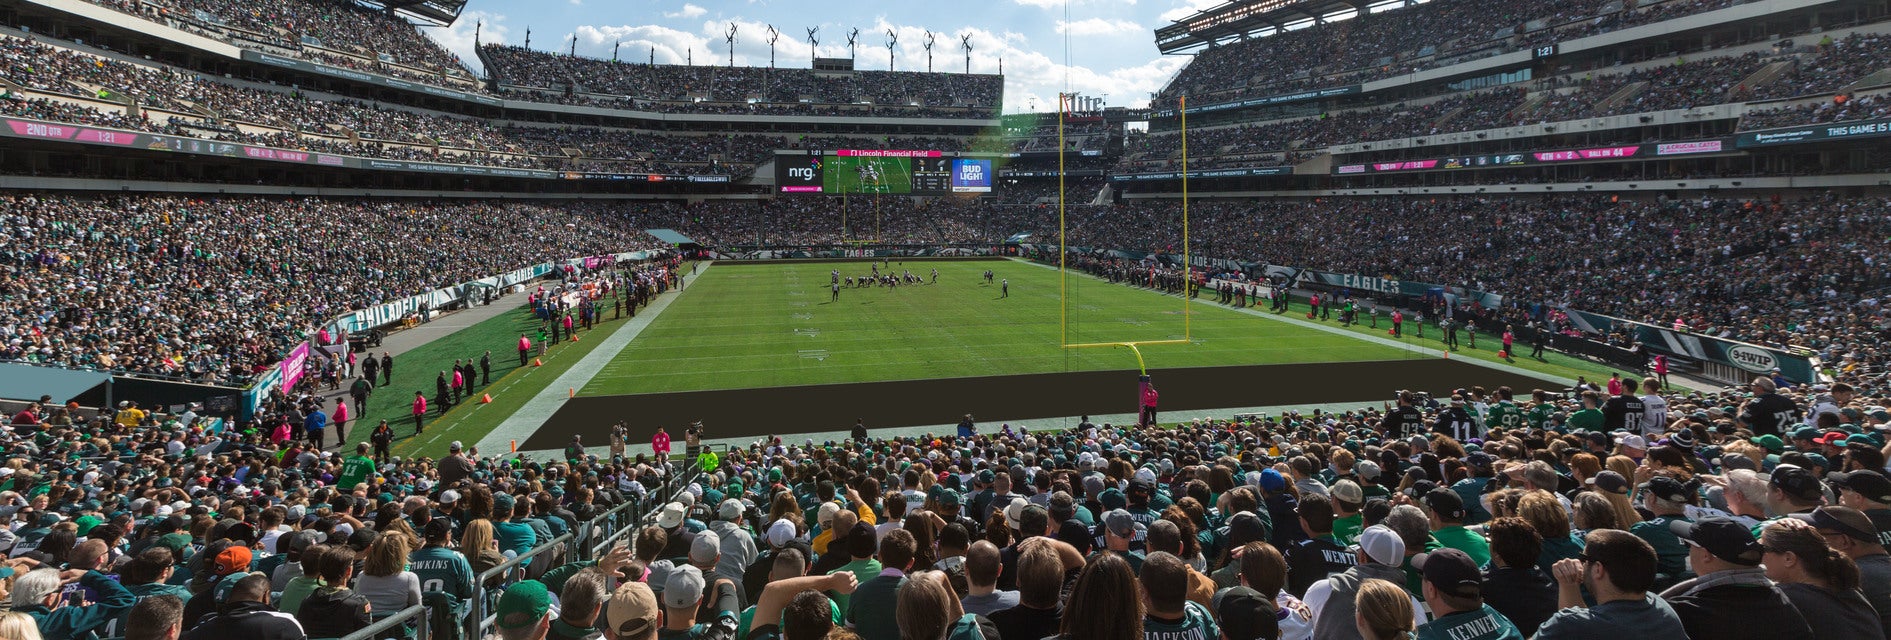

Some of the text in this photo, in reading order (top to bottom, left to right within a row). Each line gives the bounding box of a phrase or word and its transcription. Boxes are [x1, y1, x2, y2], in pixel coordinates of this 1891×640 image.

[1538, 46, 1552, 56] 1:21
[27, 123, 47, 135] 2ND
[1827, 122, 1888, 137] THIS GAME IS
[98, 131, 115, 143] 1:21
[858, 149, 882, 157] Lincoln
[883, 149, 912, 157] Financial
[1541, 152, 1554, 160] 4TH
[1567, 151, 1572, 159] 2
[1613, 148, 1623, 156] 44
[789, 167, 813, 181] nrg
[962, 165, 981, 173] BUD
[844, 249, 875, 257] EAGLES
[1178, 254, 1231, 269] PILADEPHI
[513, 266, 534, 284] EAGLES
[1343, 273, 1400, 294] EAGLES
[1625, 412, 1643, 431] 87
[1774, 409, 1798, 433] 25
[1401, 422, 1419, 440] 93
[1450, 420, 1471, 442] 11
[343, 464, 358, 477] 11
[1321, 549, 1358, 566] WENTZ
[411, 559, 449, 570] AWKINS
